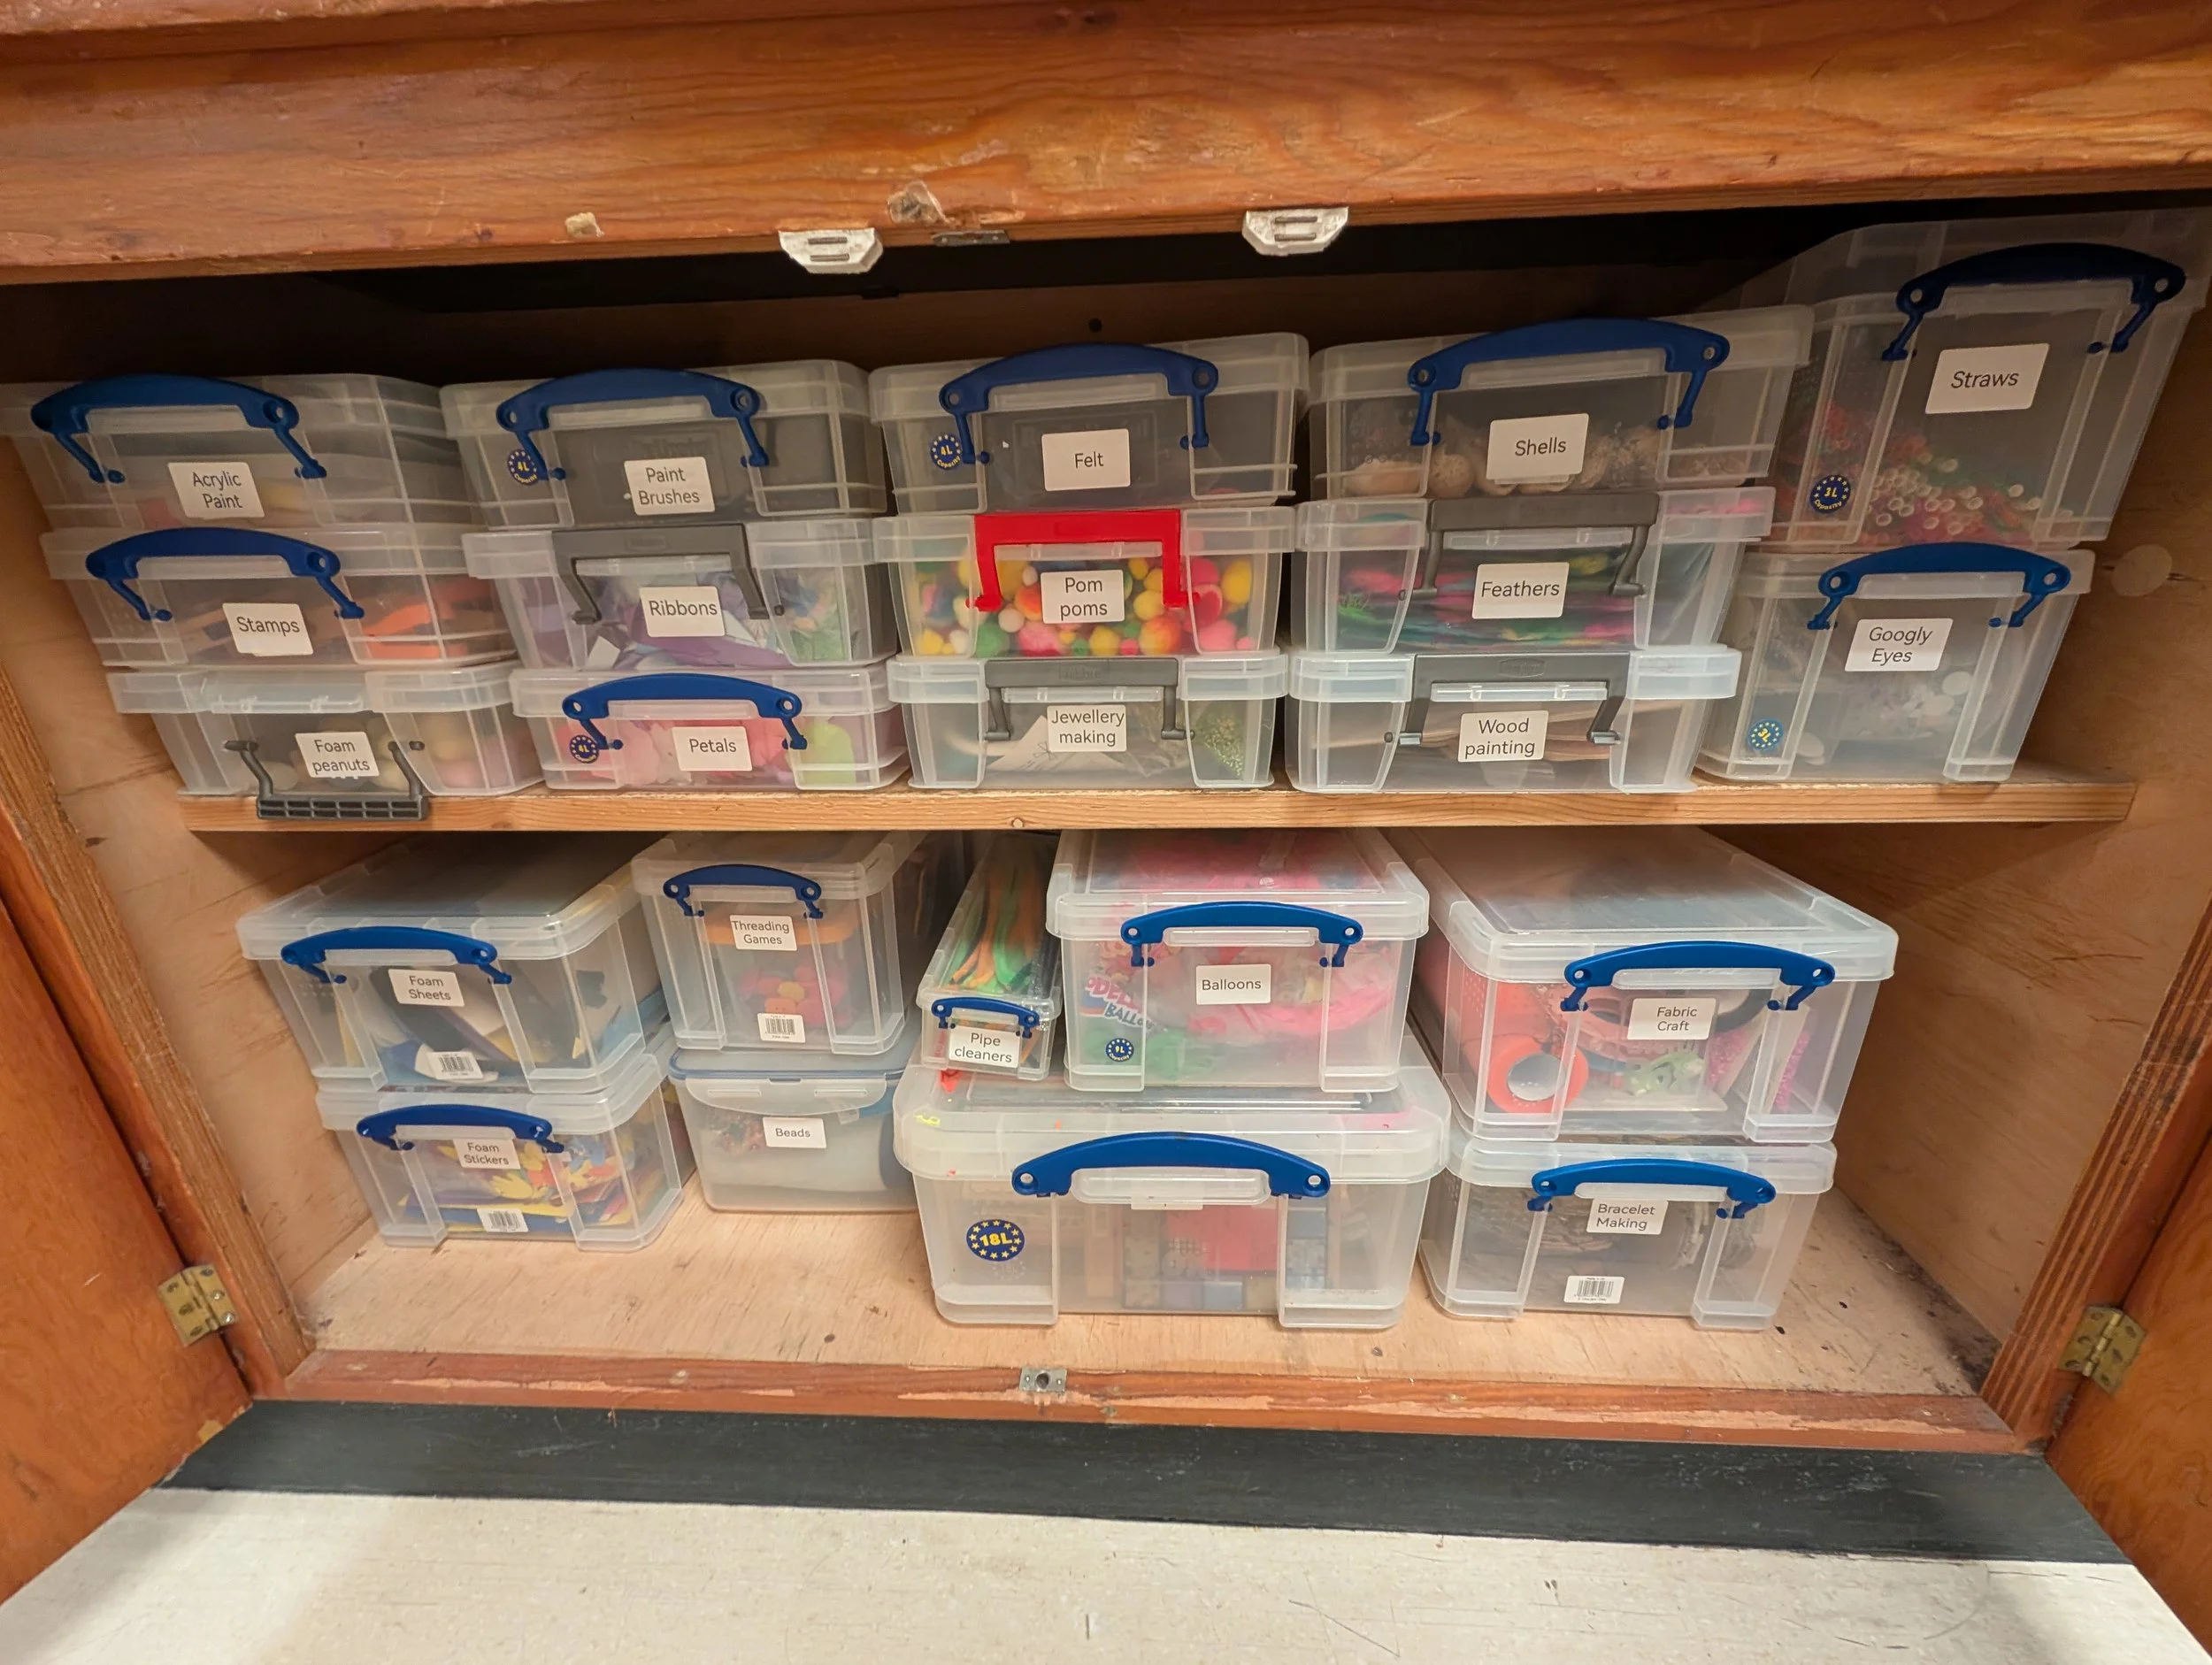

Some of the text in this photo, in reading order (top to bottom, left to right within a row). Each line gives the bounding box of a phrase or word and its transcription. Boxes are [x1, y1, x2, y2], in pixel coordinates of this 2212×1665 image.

[1951, 371, 2019, 388] Straws
[941, 444, 953, 456] 4L
[1515, 437, 1566, 456] Shells
[518, 461, 530, 472] 4L
[1075, 451, 1103, 468] Felt
[193, 471, 242, 491] Acrylic
[646, 467, 686, 483] Paint
[639, 488, 700, 505] Brushes
[1824, 487, 1838, 497] 3L
[203, 494, 242, 508] Paint
[1065, 578, 1102, 593] Pom
[1482, 580, 1559, 597] Feathers
[649, 600, 717, 616] Ribbons
[1061, 603, 1107, 621] poms
[237, 617, 300, 636] Stamps
[1870, 626, 1932, 645] Googly
[1871, 648, 1912, 666] Eyes
[1051, 710, 1125, 726] Jewellery
[1479, 717, 1529, 733] Wood
[1060, 730, 1115, 747] making
[1757, 727, 1771, 743] 3L
[314, 740, 355, 752] Foam
[578, 744, 590, 753] 4L
[689, 738, 736, 752] Petals
[1465, 740, 1535, 758] painting
[312, 759, 370, 775] peanuts
[732, 920, 790, 934] Threading
[743, 934, 782, 946] Games
[410, 976, 444, 987] Foam
[1202, 979, 1261, 990] Balloons
[409, 989, 451, 1001] Sheets
[1657, 1007, 1697, 1017] Fabric
[1657, 1020, 1689, 1031] Craft
[972, 1032, 1001, 1047] Pipe
[954, 1047, 1012, 1063] cleaners
[775, 1127, 810, 1138] Beads
[467, 1142, 500, 1154] Foam
[464, 1155, 509, 1164] Stickers
[1598, 1204, 1655, 1215] Bracelet
[1596, 1217, 1647, 1231] Making
[979, 1232, 1013, 1247] 18L
